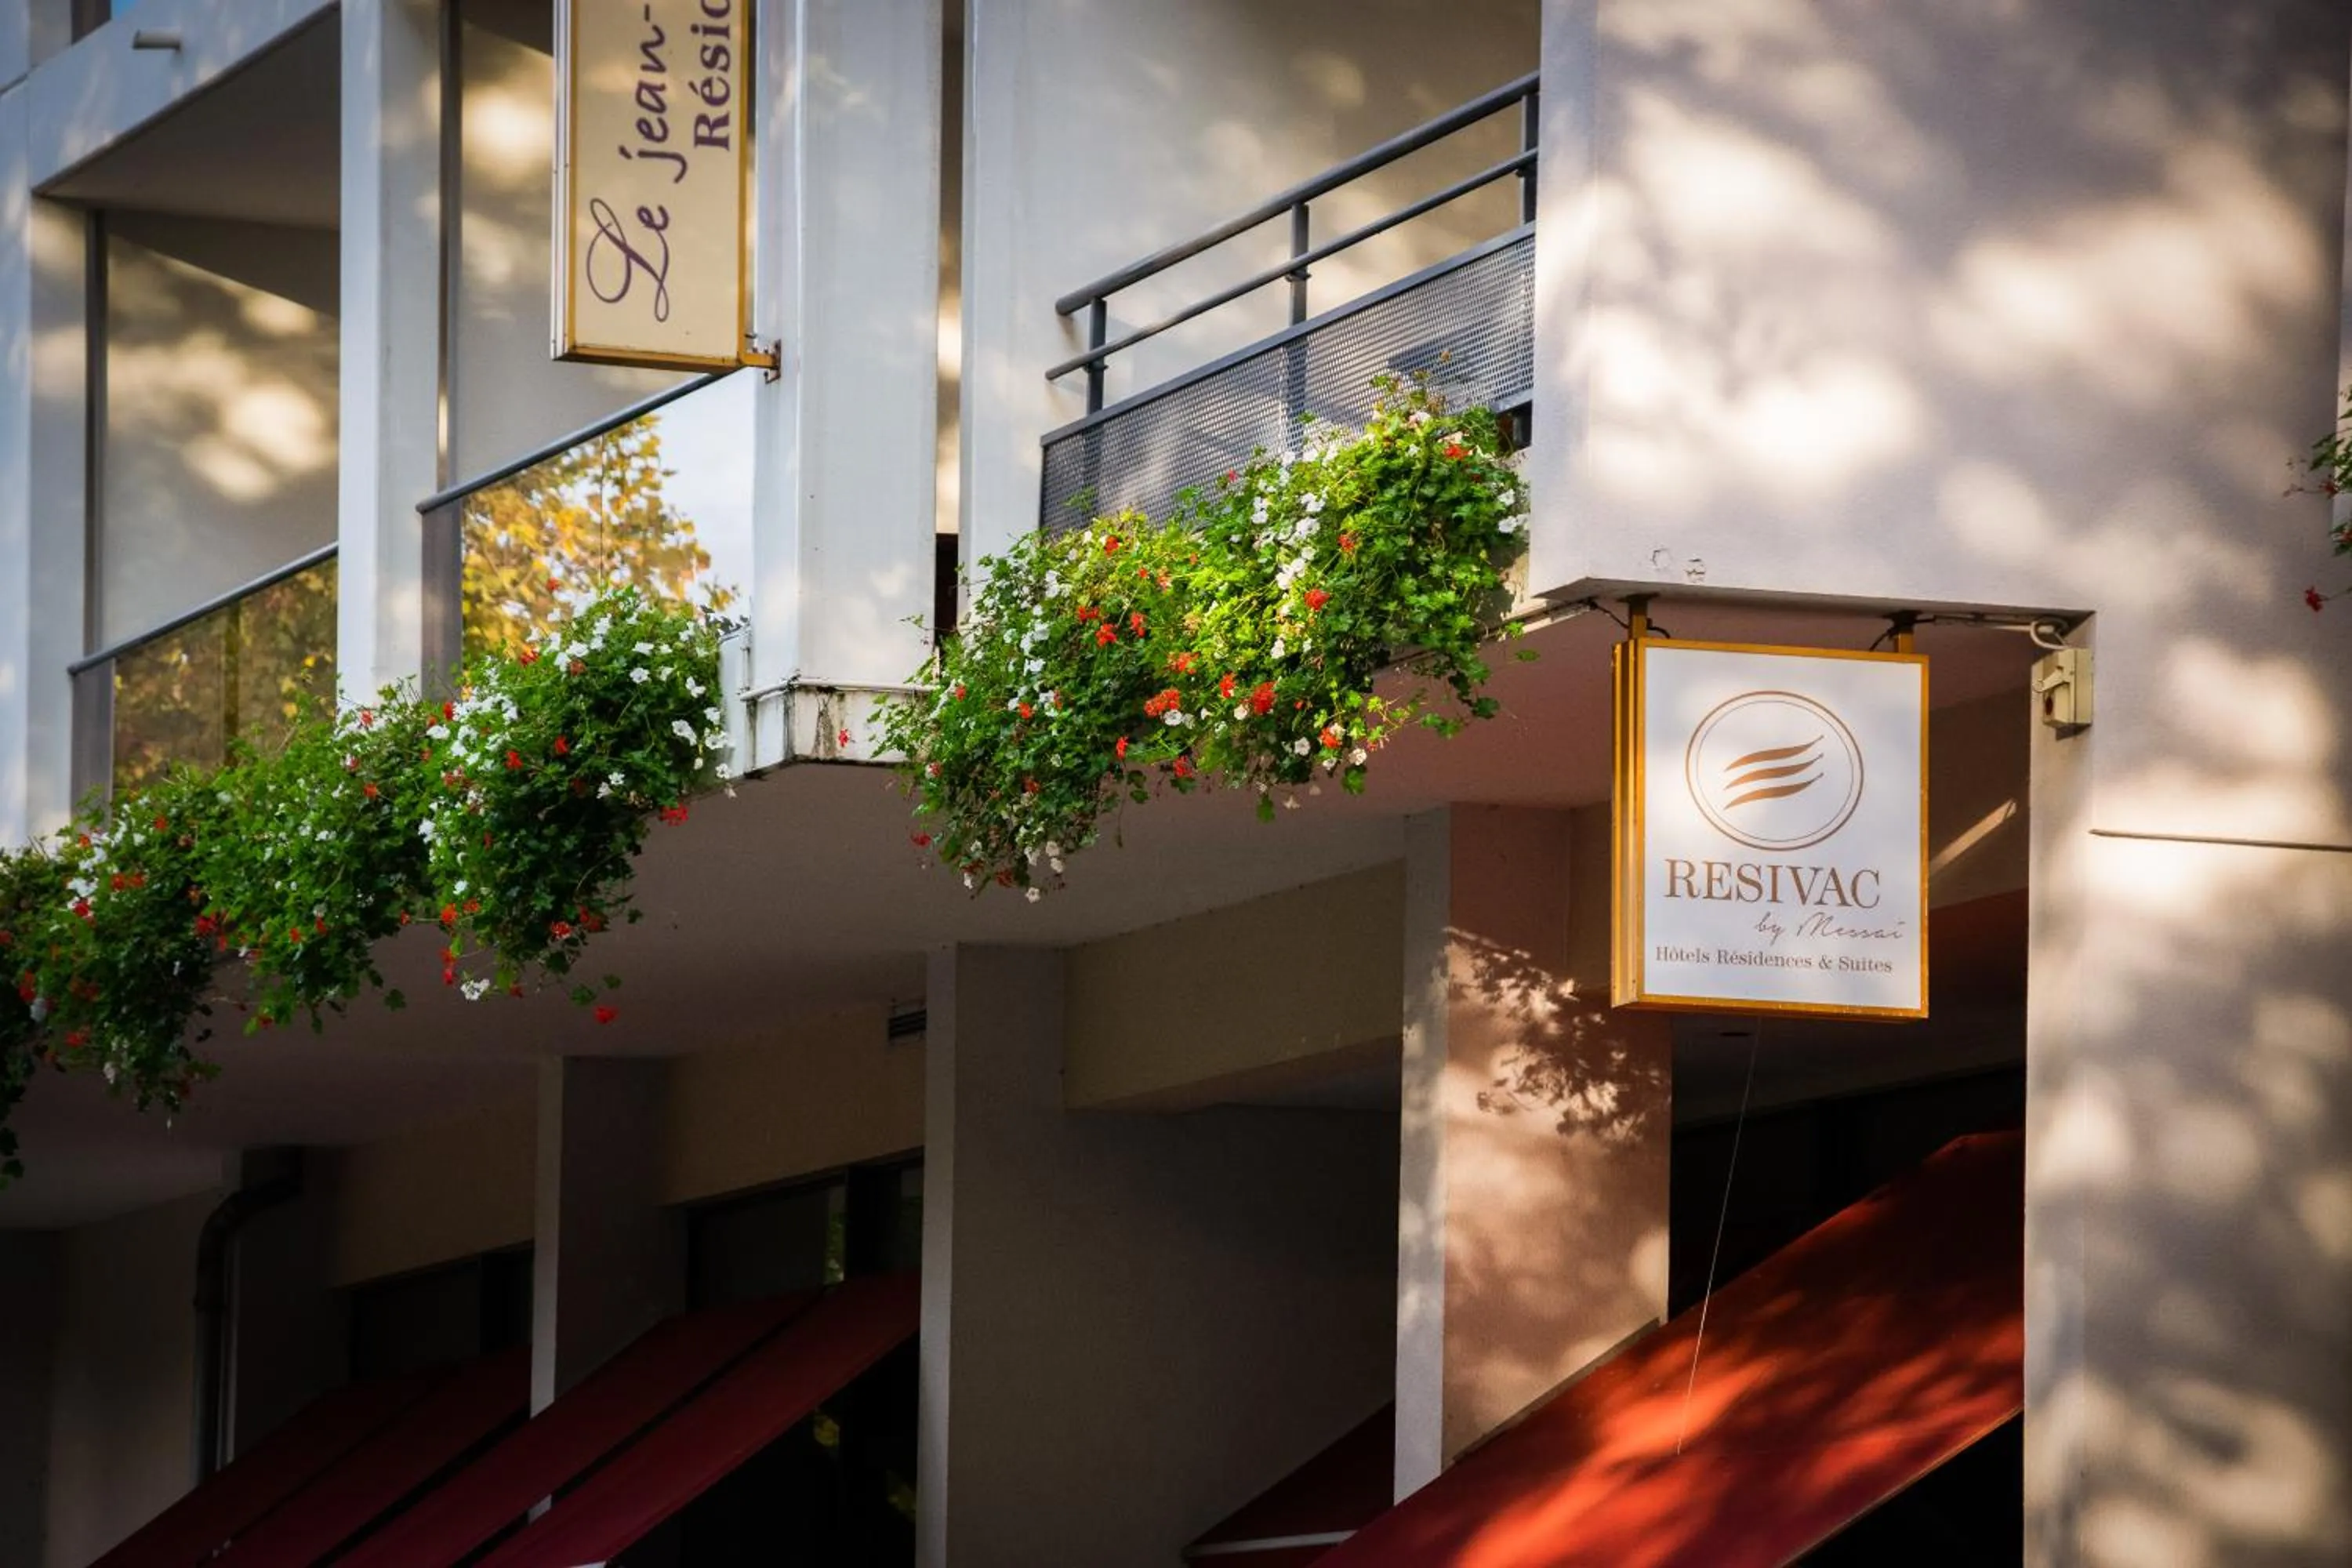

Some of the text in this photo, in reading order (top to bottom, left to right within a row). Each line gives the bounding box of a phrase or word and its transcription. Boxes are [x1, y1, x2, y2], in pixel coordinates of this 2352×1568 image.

[586, 198, 670, 323] Le
[1664, 858, 1881, 909] RESIVAC
[1754, 910, 1787, 946] by
[1655, 946, 1893, 974] Hôtels Résidences & Suites
